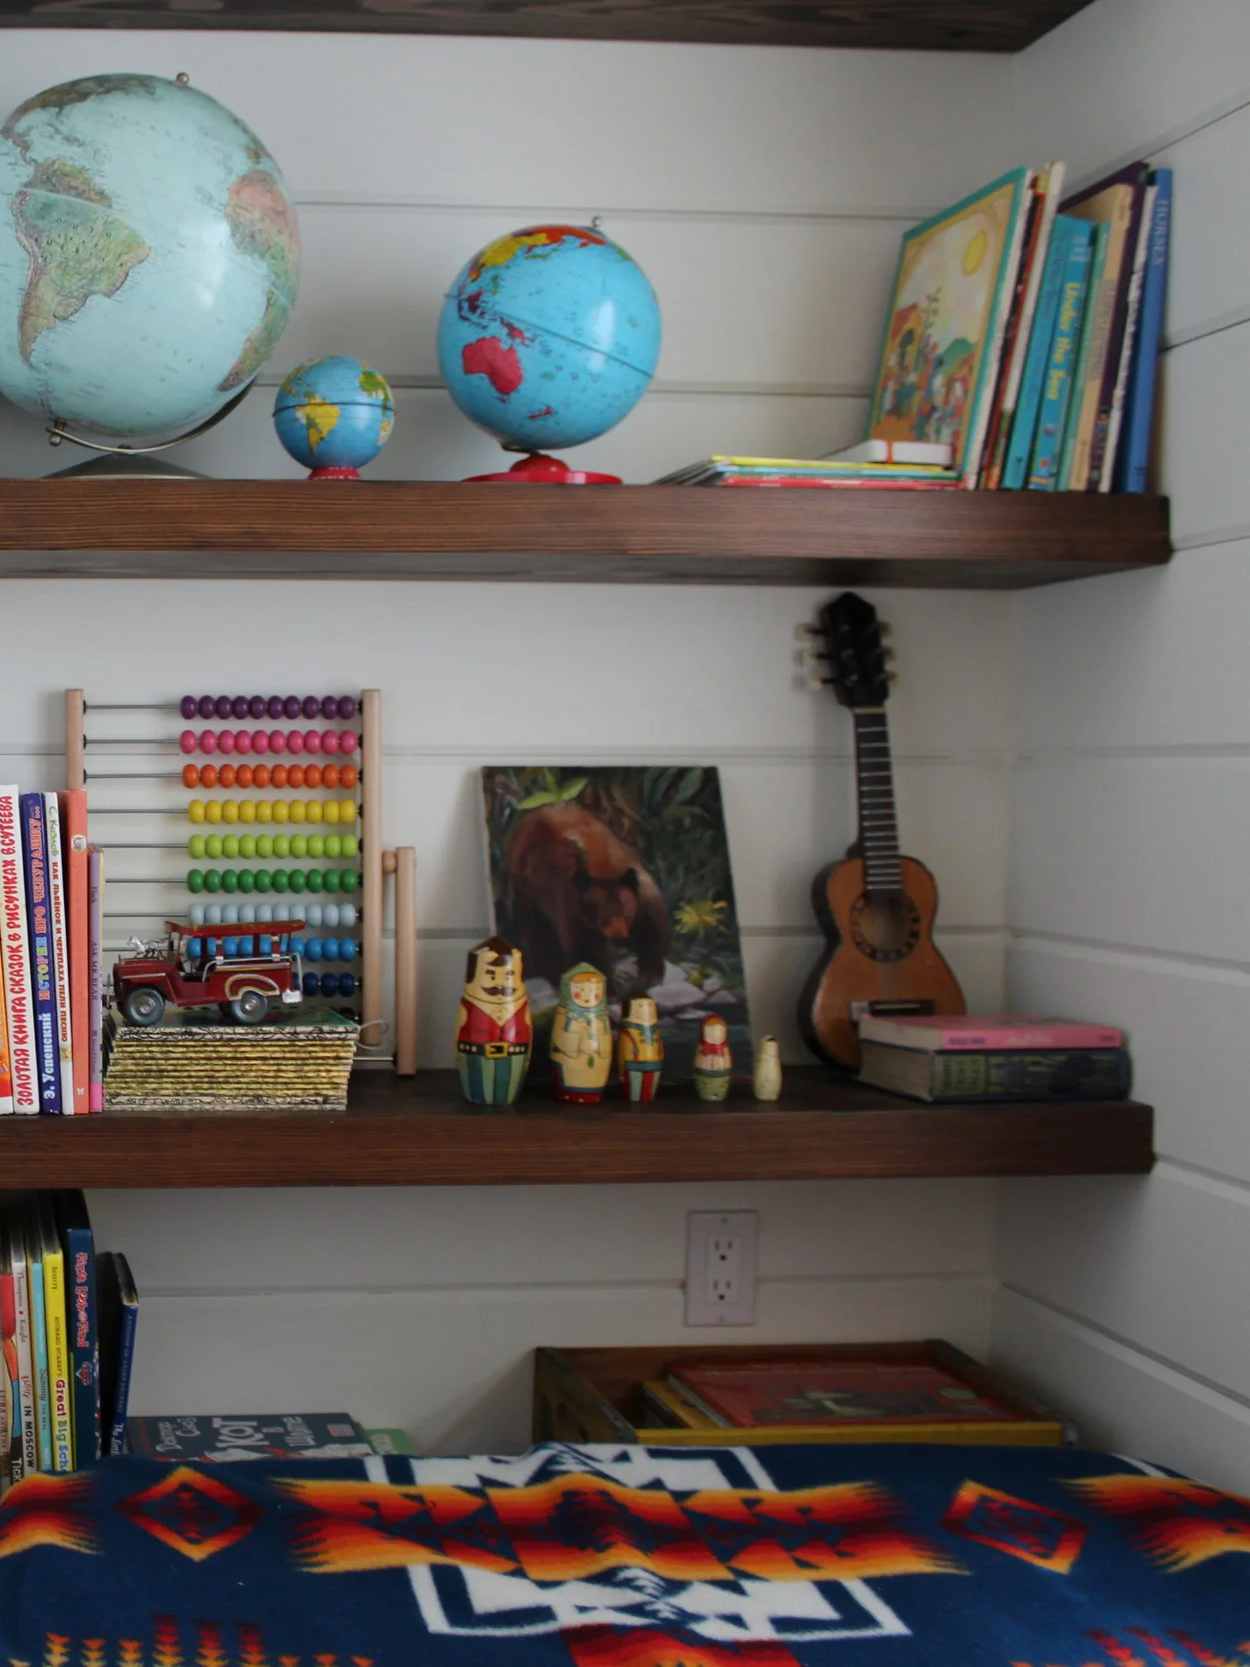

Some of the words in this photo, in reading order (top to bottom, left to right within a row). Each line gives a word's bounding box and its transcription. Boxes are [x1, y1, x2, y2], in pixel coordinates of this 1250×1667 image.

[1059, 281, 1082, 333] Under
[49, 819, 60, 857] Козлов
[51, 861, 60, 880] КАК
[2, 858, 22, 930] РИСУНКАХ
[52, 883, 62, 925] ЛЬВЁНОК
[33, 905, 47, 935] ПРО
[55, 927, 63, 935] И
[6, 943, 27, 995] СКАЗОК
[35, 936, 51, 1001] ИСТОРИИ
[56, 936, 66, 982] ЧЕРЕПАХА
[58, 984, 67, 1008] ПЕЛИ
[11, 996, 29, 1046] КНИГА
[59, 1010, 68, 1042] ПЕСНЮ
[38, 1012, 55, 1084] Успенский
[13, 1047, 34, 1106] ЗОЛОТАЯ
[43, 1085, 56, 1100] Э.
[51, 1266, 59, 1290] Scarry
[75, 1252, 88, 1284] First
[75, 1286, 89, 1312] Look
[77, 1321, 89, 1348] Find
[39, 1367, 49, 1402] Sammy
[55, 1379, 67, 1418] Great
[23, 1405, 32, 1418] IN
[24, 1420, 35, 1470] MOSCOW
[56, 1420, 68, 1443] Big
[211, 1417, 270, 1449] КОТ
[11, 1457, 23, 1482] TICK
